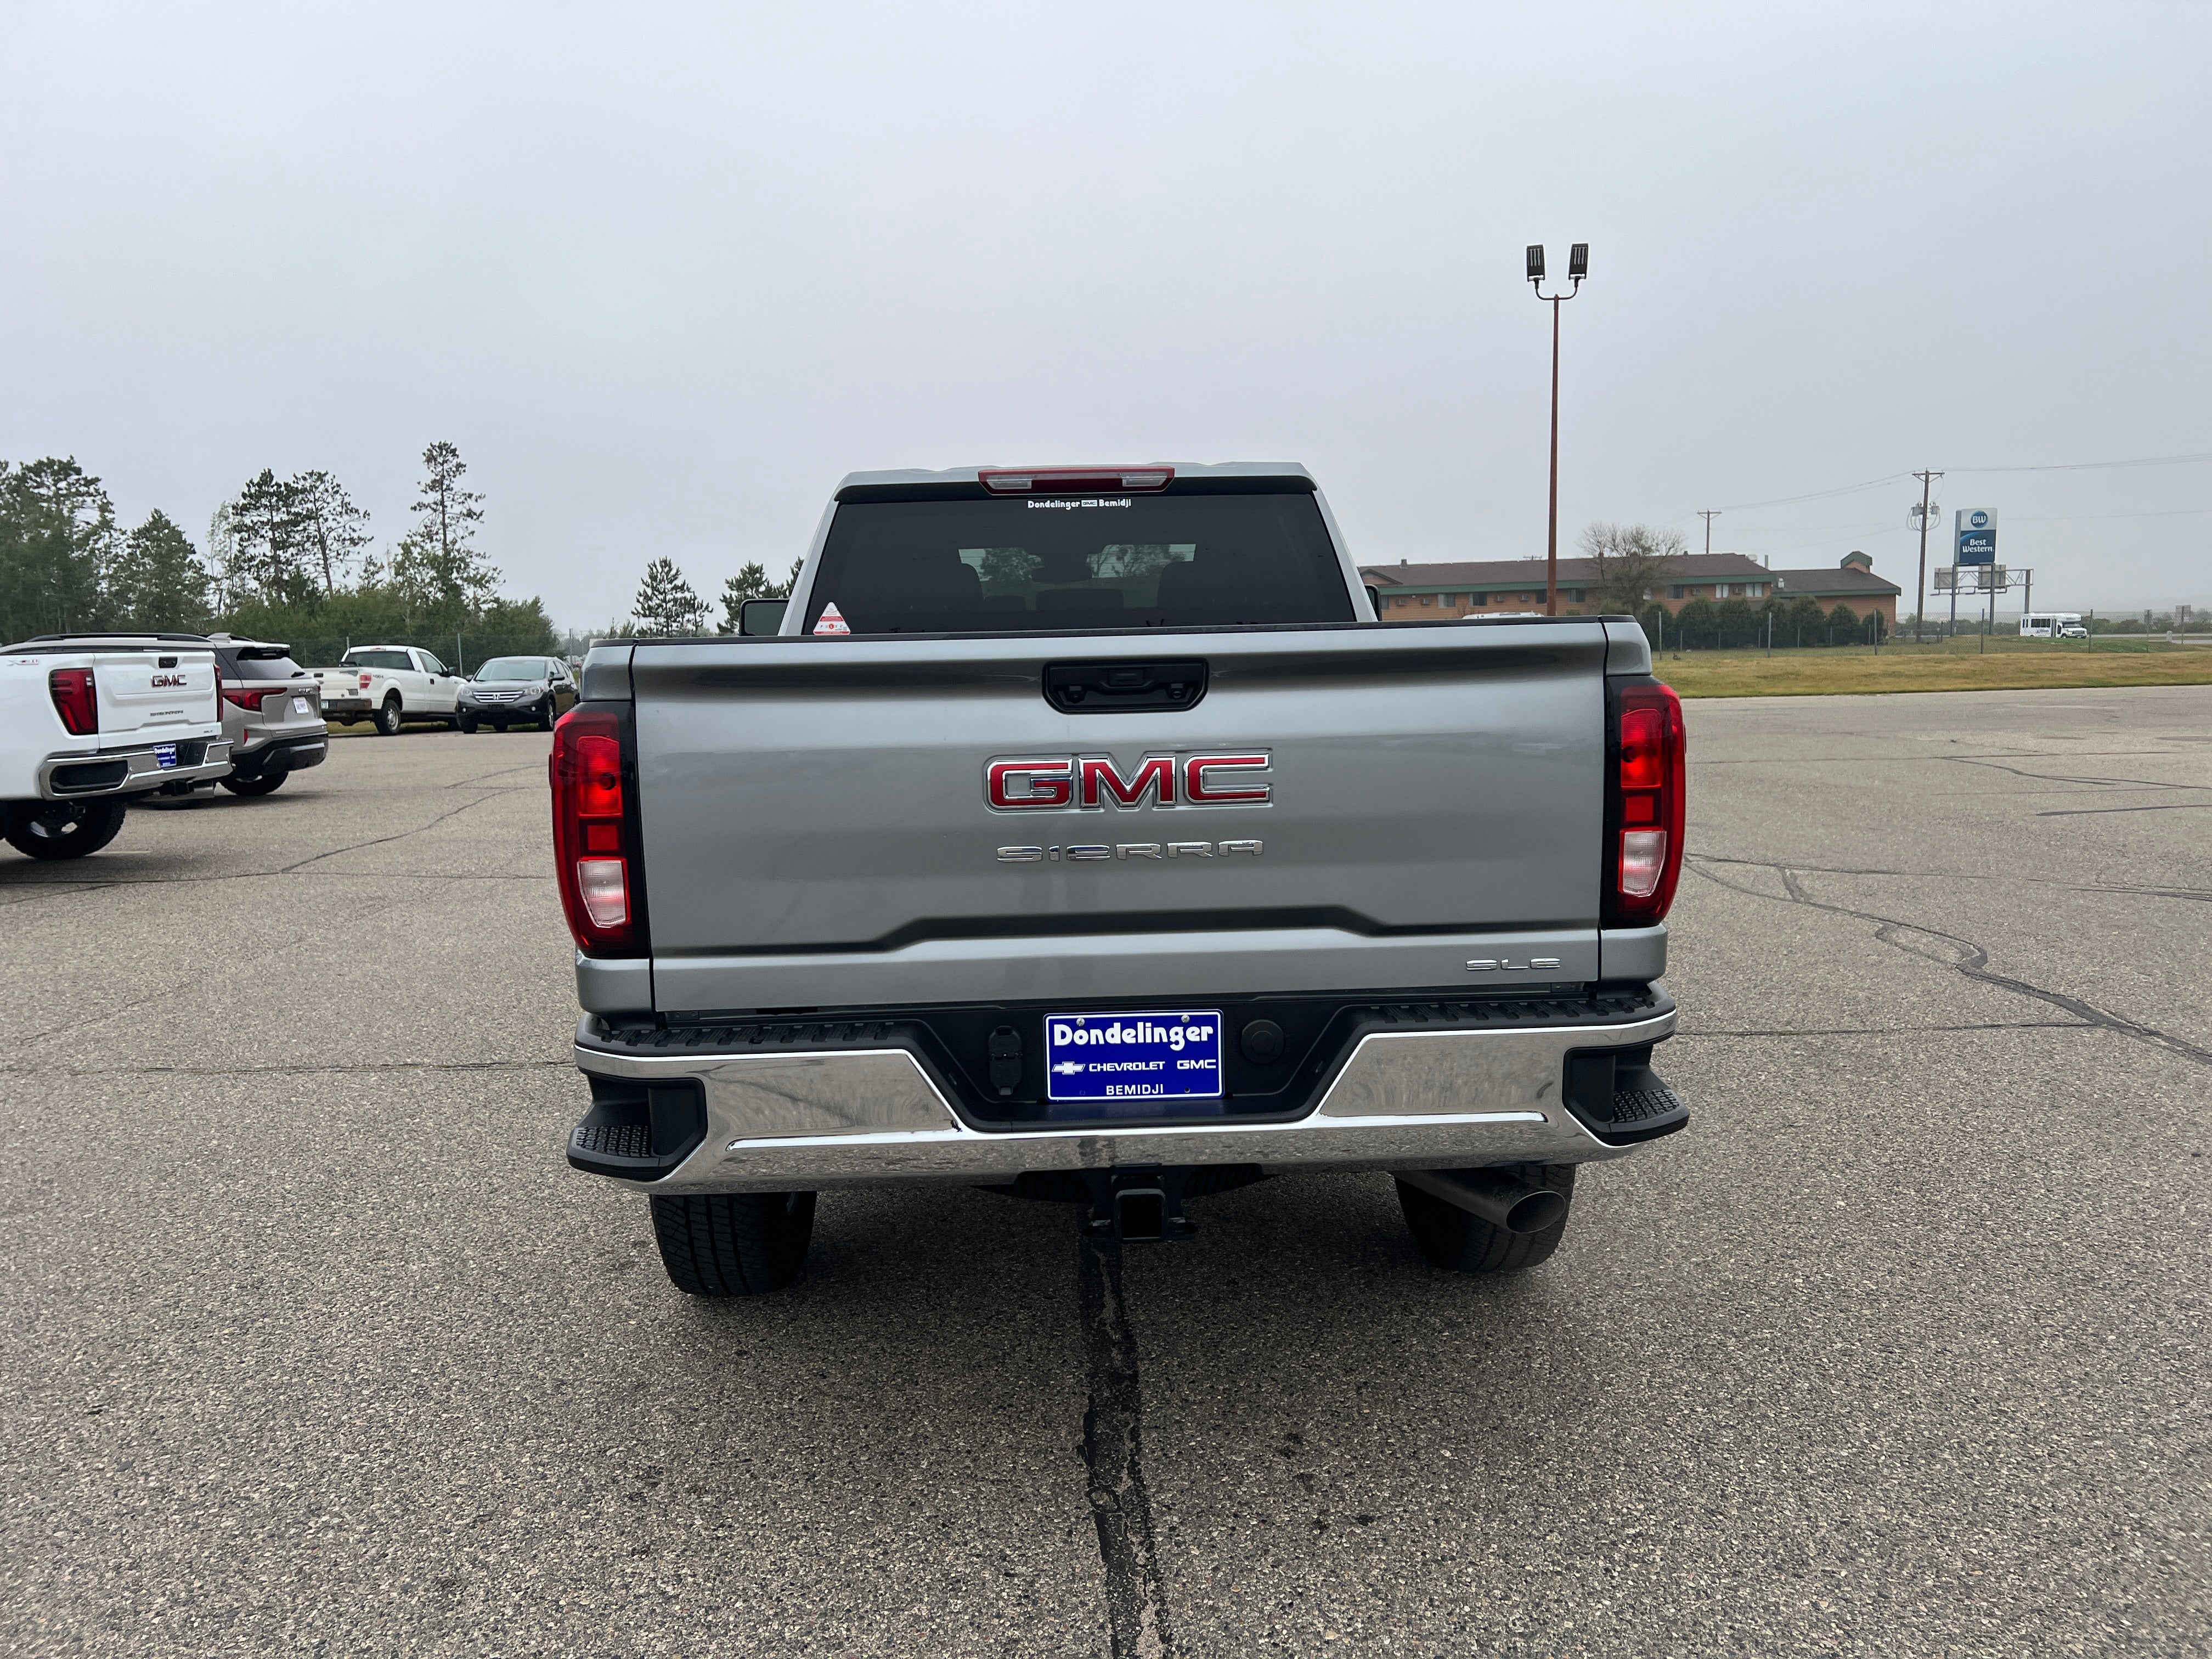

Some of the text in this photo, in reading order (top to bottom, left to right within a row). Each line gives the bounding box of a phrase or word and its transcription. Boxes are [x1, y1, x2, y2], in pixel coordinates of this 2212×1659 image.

[1028, 500, 1080, 510] Dondelinger
[1099, 499, 1131, 508] Bemidji
[151, 674, 187, 687] GMC
[986, 753, 1273, 811] GMC
[997, 840, 1263, 862] SIERRA
[1466, 958, 1560, 970] SLE
[1054, 1022, 1214, 1051] Dondelinger
[1089, 1059, 1216, 1072] CHEVROLET GMC
[1106, 1084, 1164, 1096] BEMIDJI
